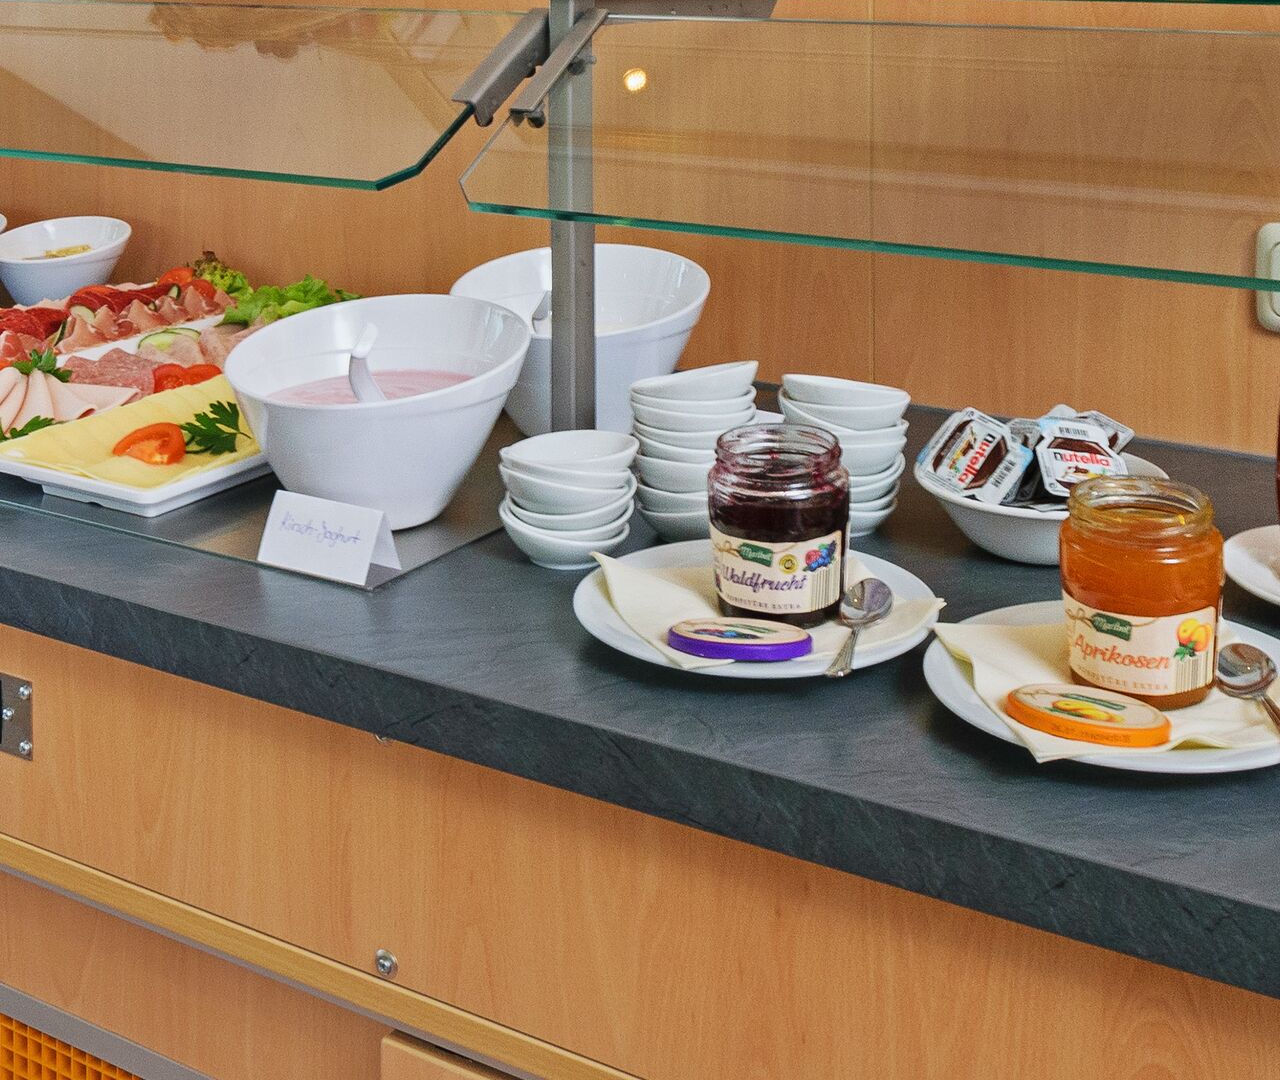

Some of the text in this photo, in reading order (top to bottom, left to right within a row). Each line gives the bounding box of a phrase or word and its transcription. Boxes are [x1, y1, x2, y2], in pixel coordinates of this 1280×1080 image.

[957, 433, 996, 484] nutella
[1052, 450, 1112, 468] nutella
[721, 565, 807, 593] Waldfrucht
[1075, 633, 1170, 670] Aprikosen
